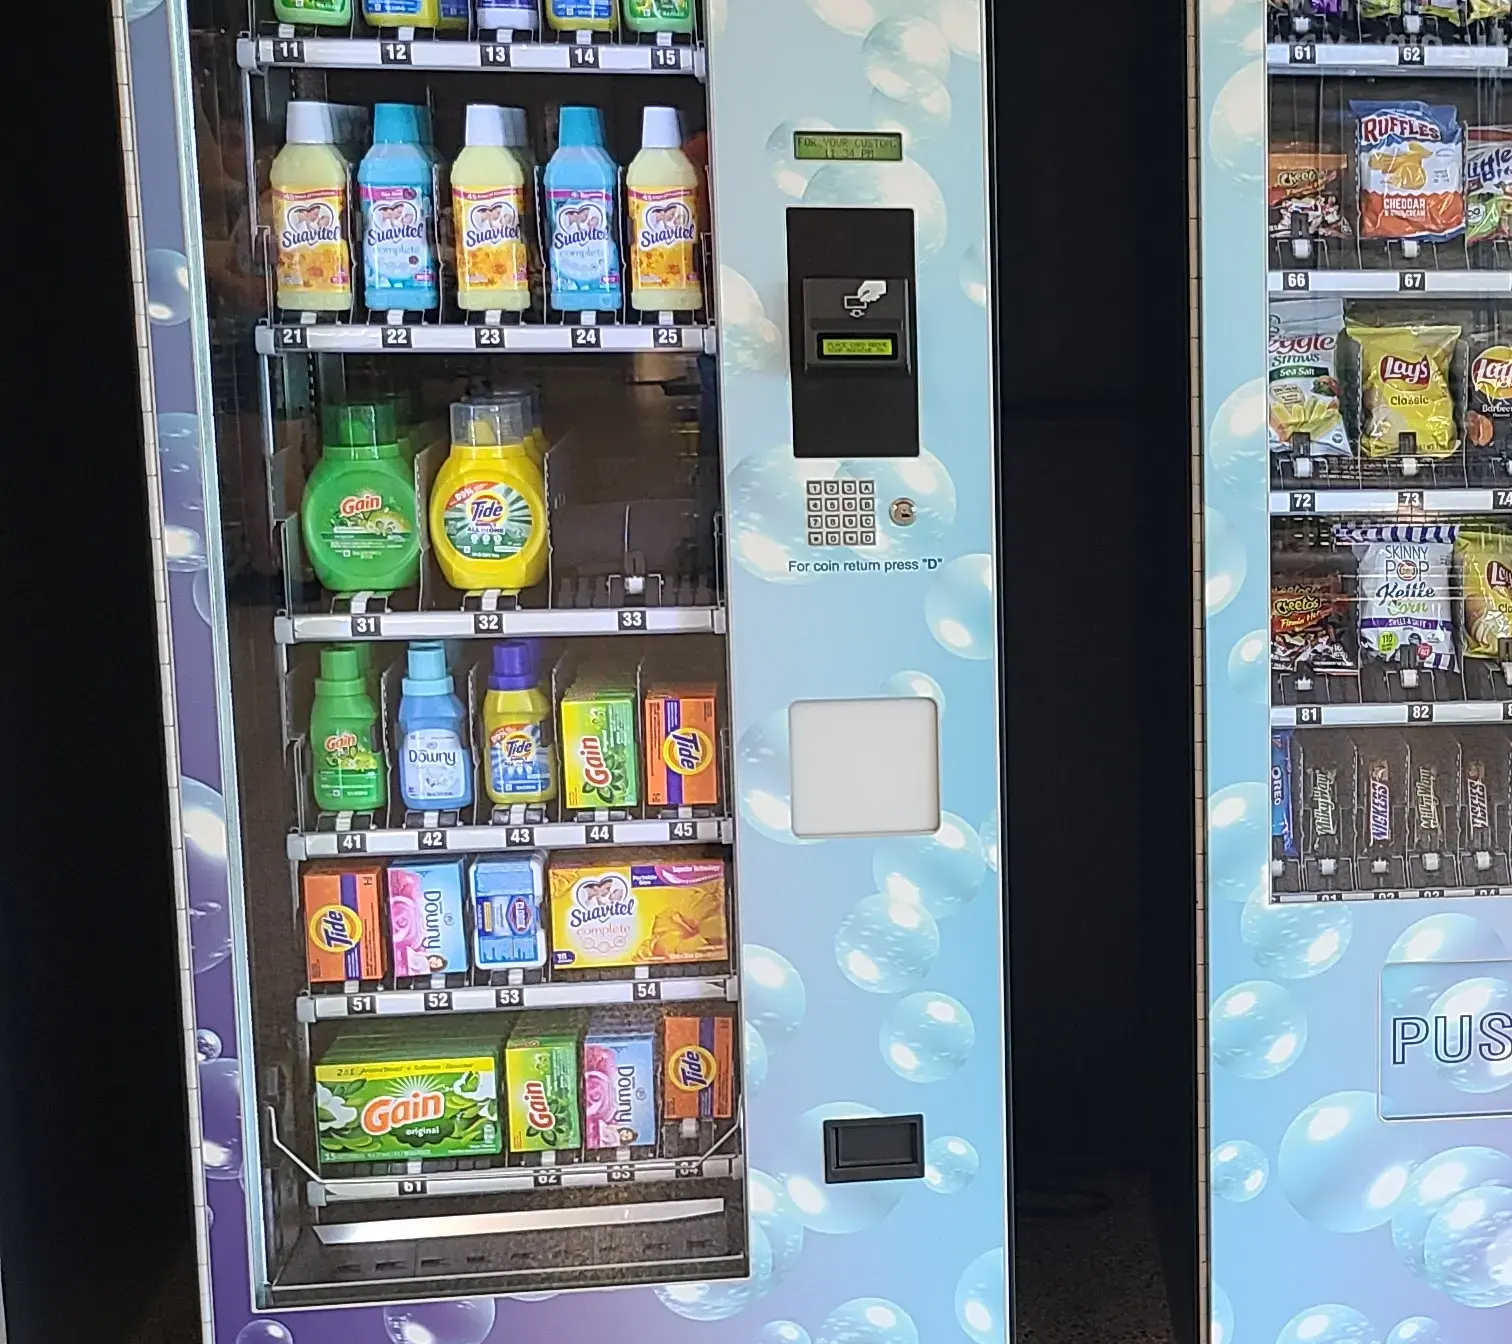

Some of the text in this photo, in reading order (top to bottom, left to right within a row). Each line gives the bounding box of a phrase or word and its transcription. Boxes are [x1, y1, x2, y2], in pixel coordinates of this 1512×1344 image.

[279, 42, 299, 57] 11
[386, 44, 407, 60] 12
[486, 46, 506, 62] 13
[574, 48, 595, 64] 14
[656, 49, 676, 65] 15
[1294, 46, 1311, 60] 61
[1403, 47, 1421, 61] 62
[1362, 116, 1440, 143] RUFFLES
[1383, 197, 1426, 210] CHEDDAR
[282, 226, 340, 248] Suavitel
[367, 225, 424, 247] Suavitel
[466, 225, 520, 248] Suavitel
[554, 227, 609, 250] Suavitel
[641, 226, 695, 248] Suavitel
[1287, 272, 1306, 287] 66
[1404, 272, 1422, 287] 67
[283, 328, 302, 344] 21
[387, 328, 408, 344] 22
[480, 328, 500, 344] 23
[576, 329, 597, 344] 24
[658, 329, 678, 344] 25
[1279, 365, 1316, 378] Sea Salt
[1383, 354, 1429, 386] Lay's
[1389, 393, 1430, 407] Classic
[341, 496, 380, 515] Gain
[1293, 493, 1312, 508] 72
[1402, 492, 1420, 506] 73
[471, 499, 504, 522] Tide
[1385, 545, 1429, 560] SKINNY
[788, 557, 943, 573] For coin return press "D"
[1385, 559, 1430, 582] POP
[1376, 581, 1436, 607] Kettle
[1274, 596, 1320, 615] Cheetos
[1387, 600, 1429, 616] Corn
[356, 618, 376, 633] 31
[478, 615, 499, 630] 32
[622, 611, 643, 627] 33
[1301, 707, 1318, 721] 81
[1412, 705, 1430, 719] 82
[325, 734, 356, 751] Gain
[506, 739, 532, 757] Tide
[408, 749, 457, 766] Downy
[671, 733, 702, 771] Tide
[580, 736, 612, 786] Gain
[1271, 766, 1282, 805] OREO
[510, 829, 530, 843] 43
[590, 825, 609, 840] 44
[673, 823, 693, 837] 45
[343, 834, 362, 850] 41
[422, 831, 443, 847] 42
[421, 890, 442, 949] Downy
[570, 899, 635, 928] Suavitel
[324, 910, 353, 949] Tide
[576, 923, 631, 937] complete
[500, 989, 521, 1004] 53
[637, 983, 657, 998] 54
[352, 996, 372, 1012] 51
[427, 993, 449, 1008] 52
[680, 1050, 708, 1087] Tide
[614, 1065, 635, 1122] Downy
[363, 1091, 442, 1133] Gain
[524, 1082, 556, 1130] Gain
[405, 1125, 440, 1138] original
